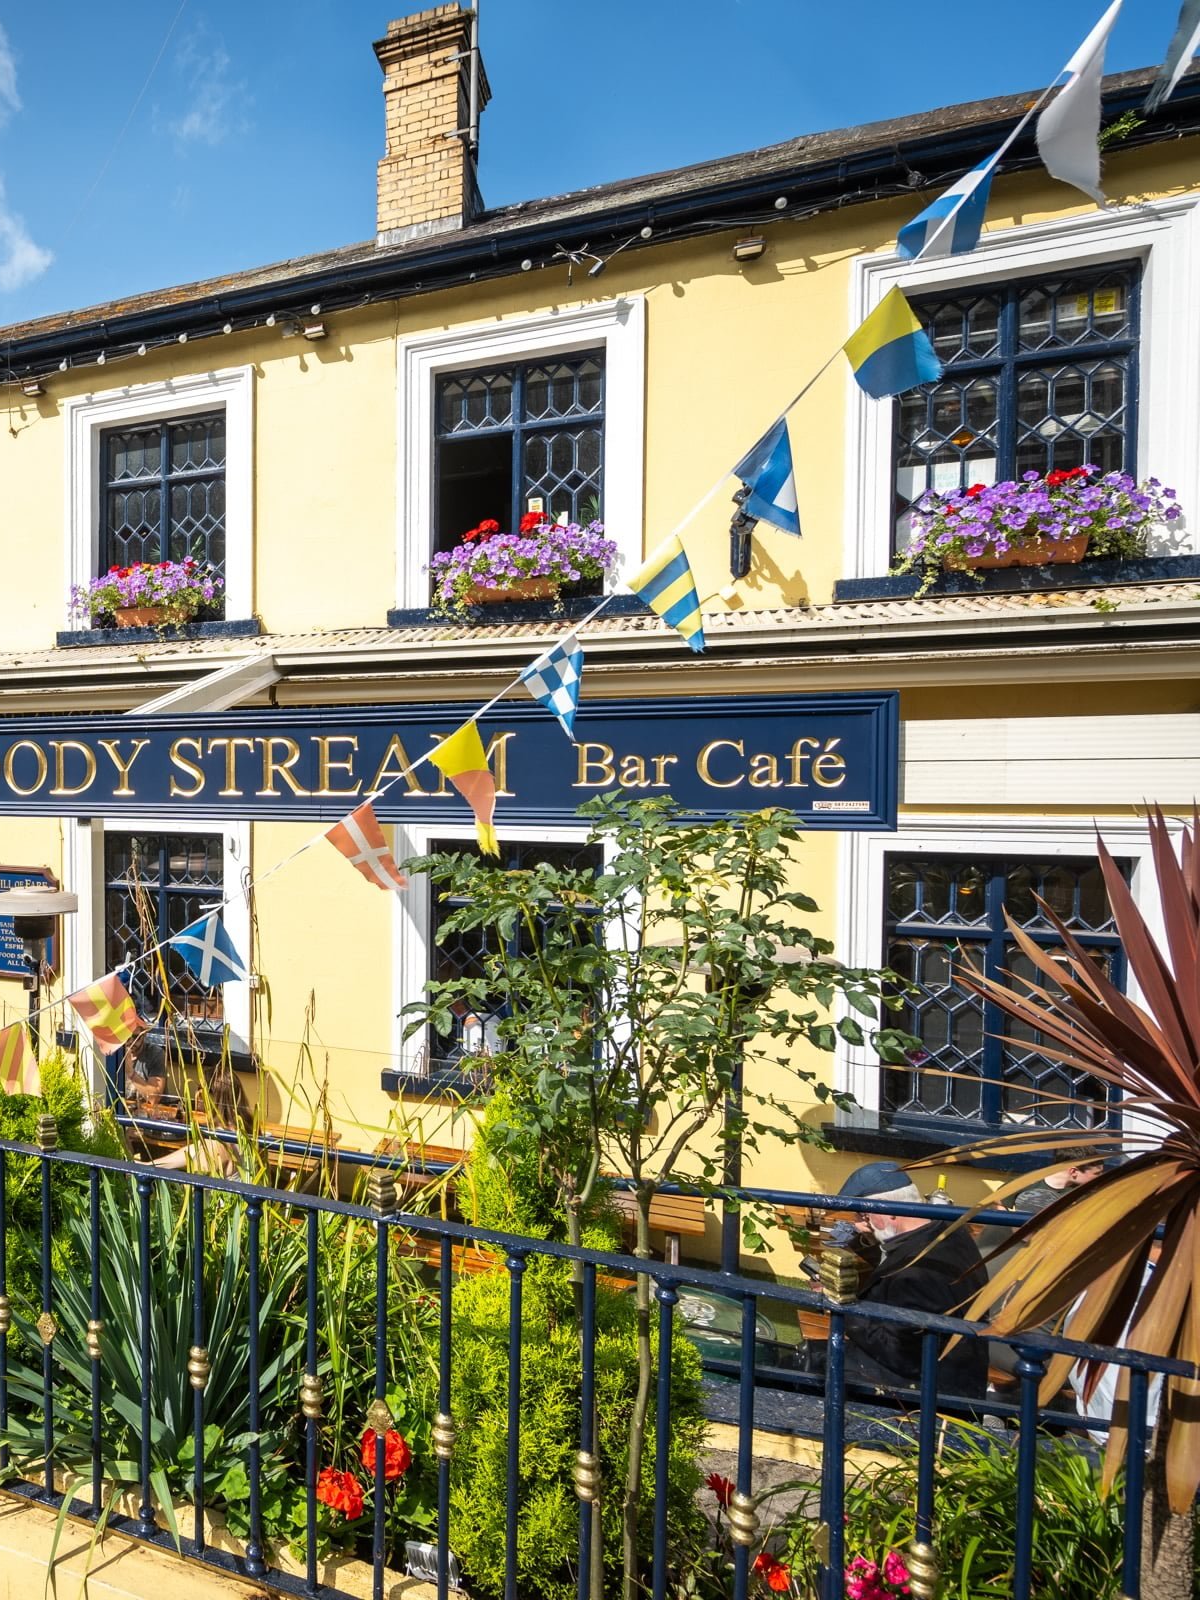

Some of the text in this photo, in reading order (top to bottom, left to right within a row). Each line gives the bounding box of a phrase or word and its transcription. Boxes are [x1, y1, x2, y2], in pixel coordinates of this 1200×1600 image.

[169, 732, 516, 798] STREAM
[571, 742, 679, 788] Bar
[696, 736, 847, 789] Café
